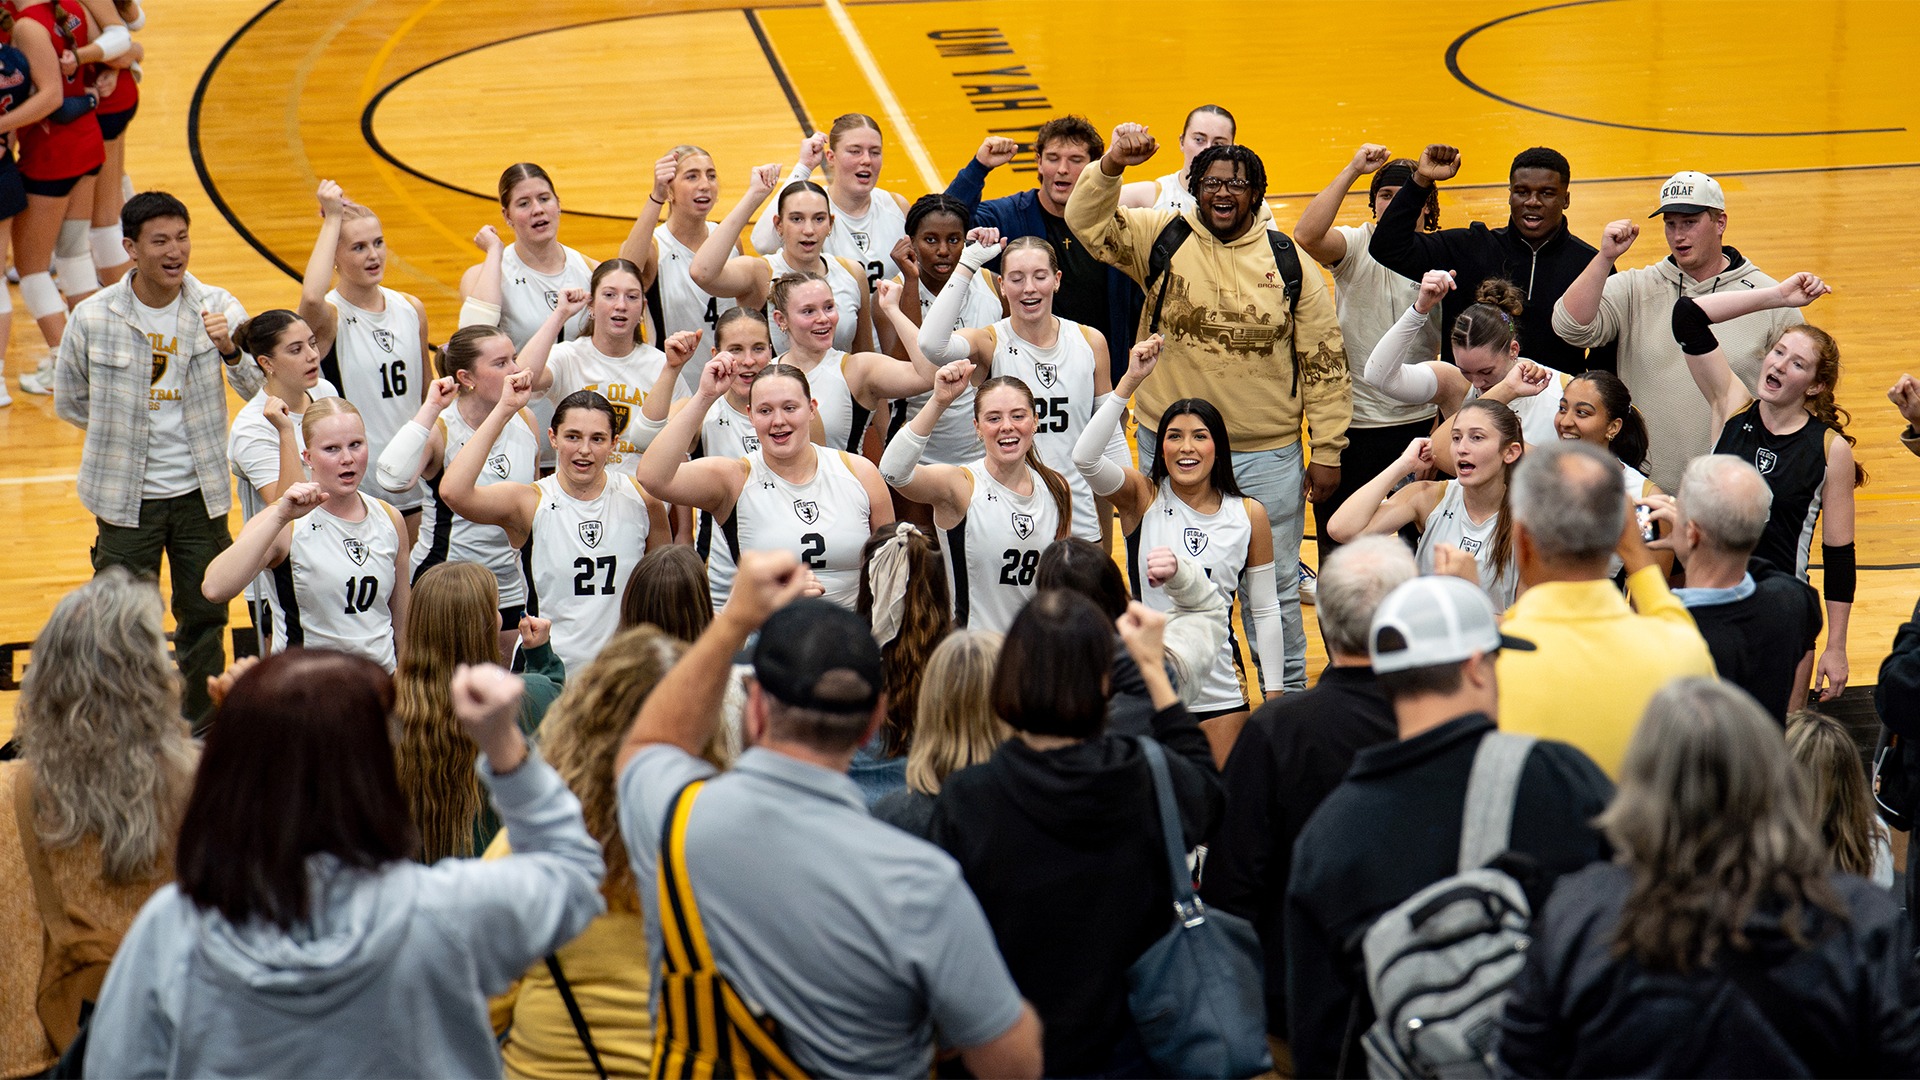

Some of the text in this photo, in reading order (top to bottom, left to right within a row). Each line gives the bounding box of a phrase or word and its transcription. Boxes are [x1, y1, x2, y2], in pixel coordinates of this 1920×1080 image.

[926, 27, 1015, 58] UM
[952, 65, 1053, 112] YAH
[704, 296, 719, 331] 4
[379, 359, 408, 399] 16
[1033, 396, 1069, 434] 25
[800, 532, 827, 569] 2
[999, 548, 1041, 587] 28
[344, 575, 379, 615] 10
[573, 555, 617, 596] 27
